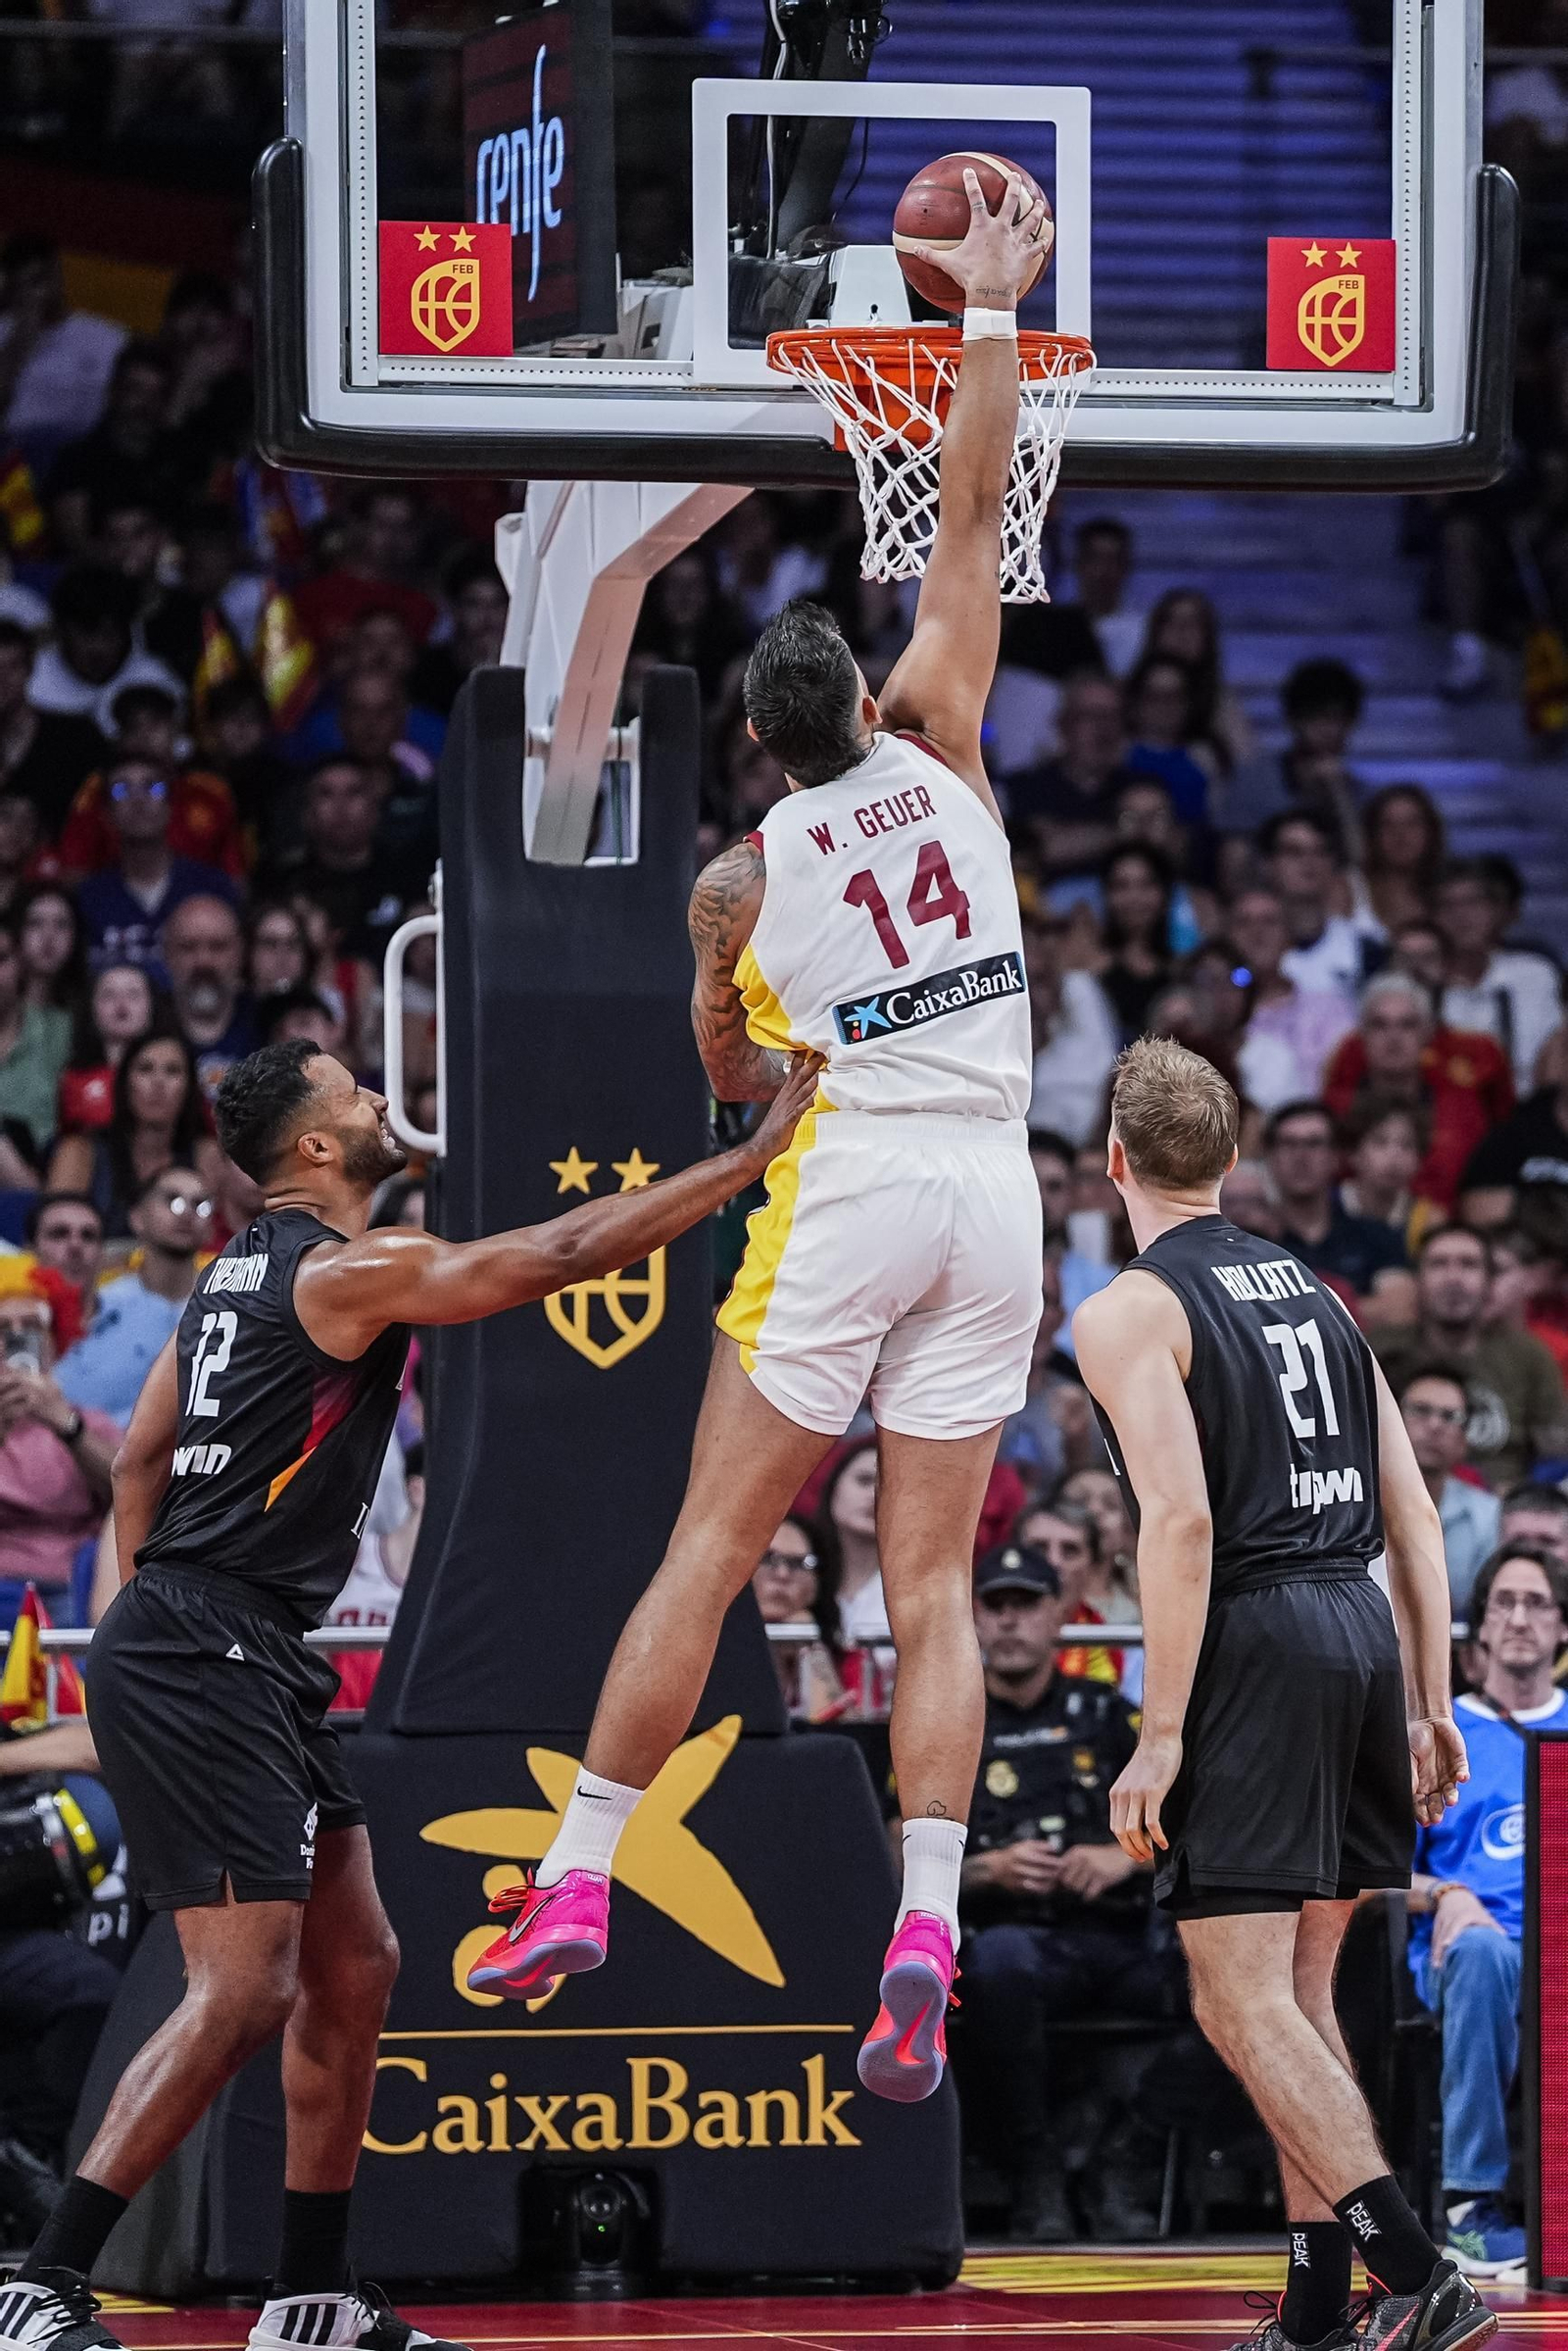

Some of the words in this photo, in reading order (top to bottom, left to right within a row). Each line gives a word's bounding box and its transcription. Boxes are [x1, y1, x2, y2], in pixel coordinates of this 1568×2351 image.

[477, 44, 564, 303] renfe
[452, 264, 474, 274] FEB
[1338, 279, 1359, 290] FEB
[807, 822, 849, 856] W.
[854, 785, 937, 839] GEUER
[843, 840, 972, 969] 14
[886, 960, 1022, 1026] CaixaBank
[1261, 1318, 1341, 1439] 21
[361, 2053, 862, 2155] CaixaBank
[1292, 2232, 1311, 2269] PEAK
[1346, 2199, 1382, 2242] PEAK
